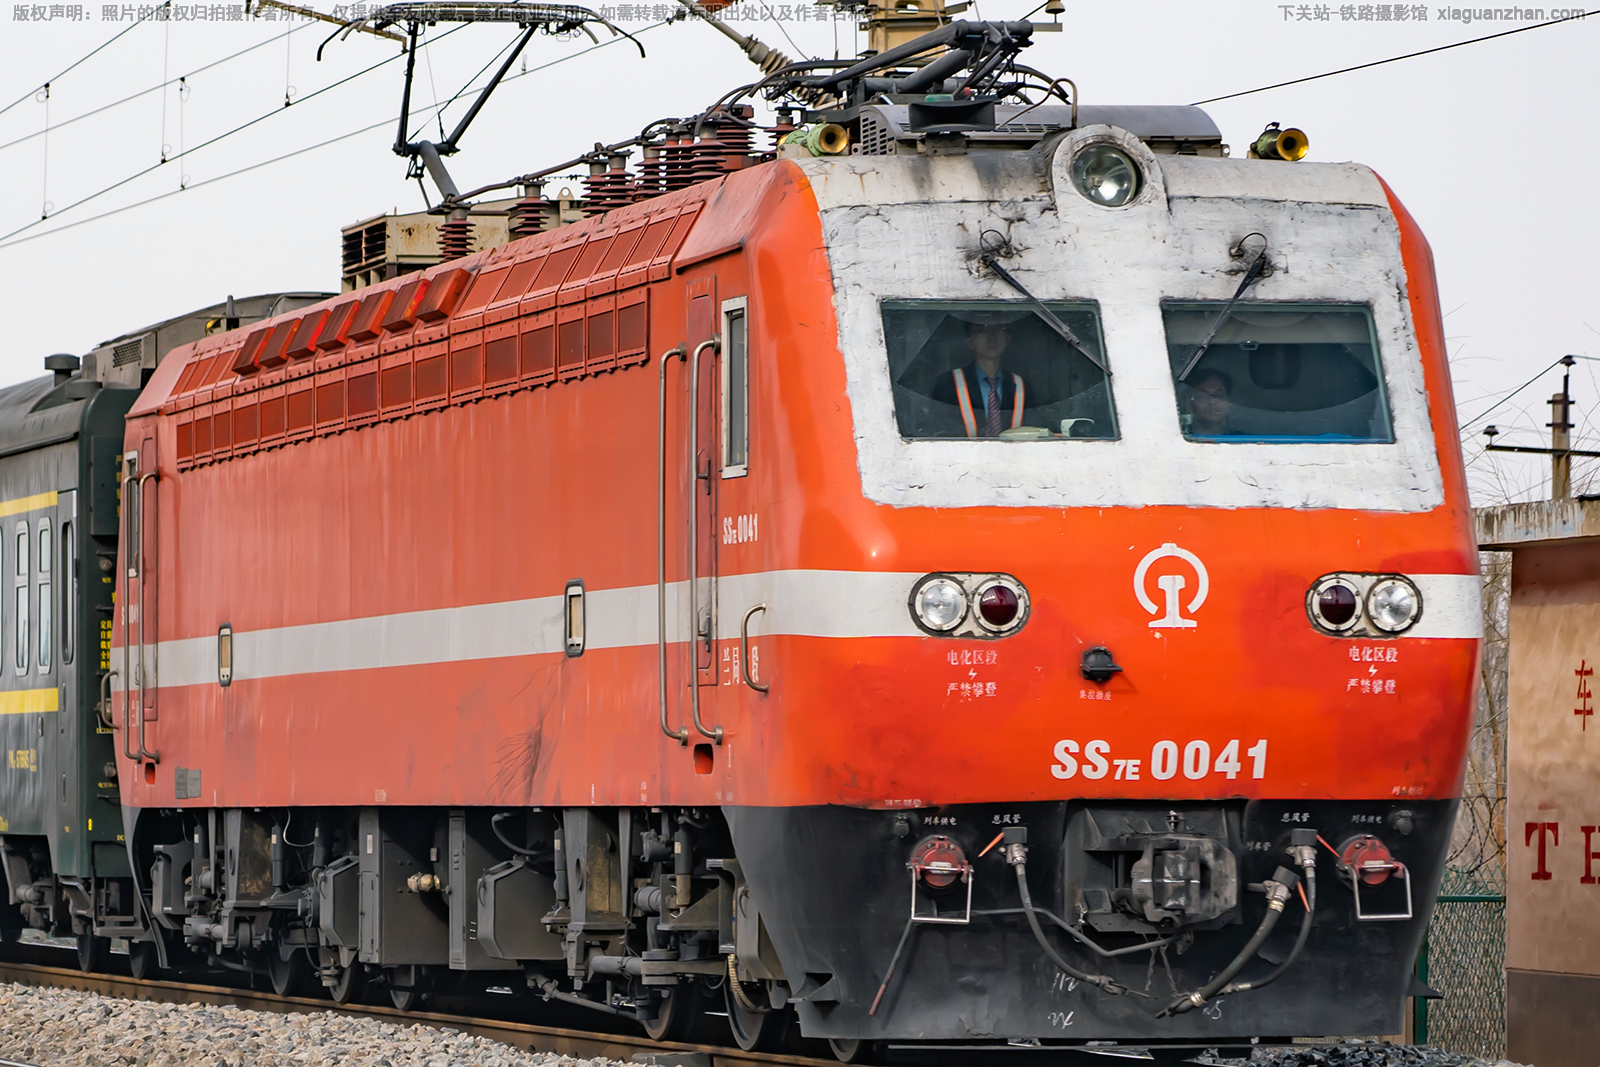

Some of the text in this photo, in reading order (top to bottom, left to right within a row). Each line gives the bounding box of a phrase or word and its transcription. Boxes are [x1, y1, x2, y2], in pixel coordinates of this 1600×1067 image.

[946, 649, 999, 667] 电化区段
[1348, 645, 1399, 663] 电化区段
[946, 681, 998, 698] 严禁攀登
[1346, 678, 1397, 695] 严禁攀登
[1050, 738, 1268, 781] SS7E 0041
[1280, 812, 1311, 823] 总风管
